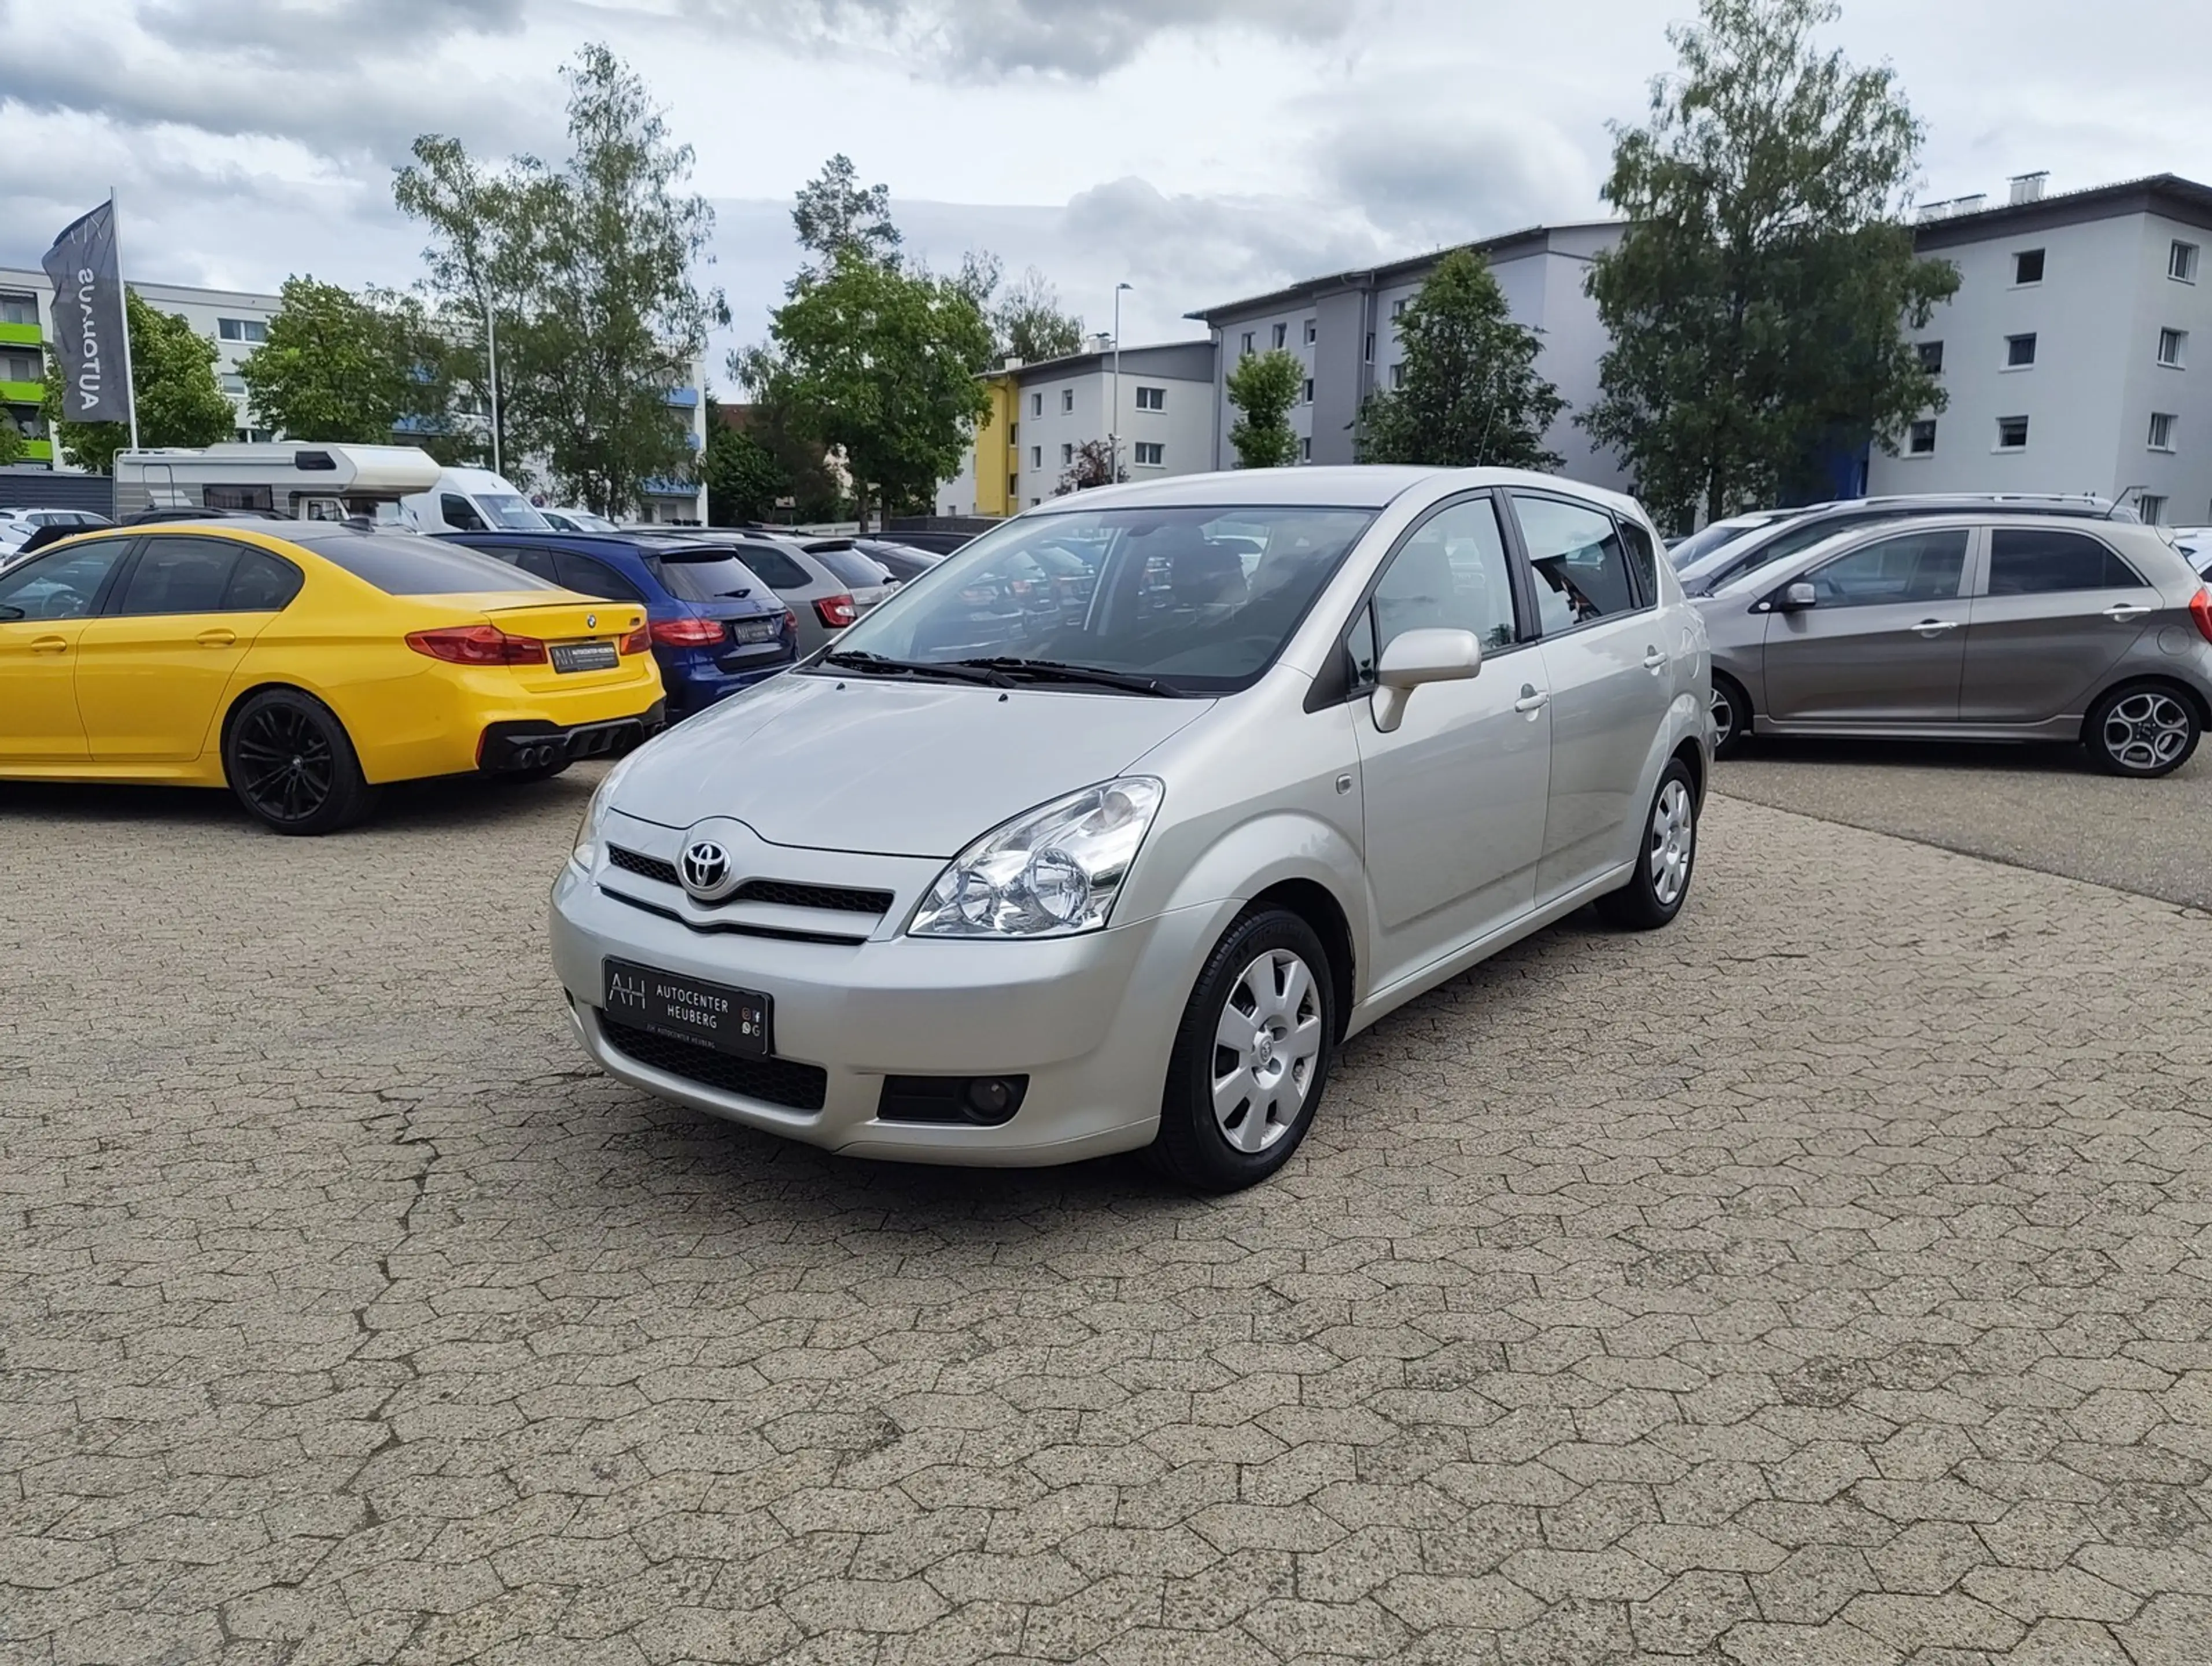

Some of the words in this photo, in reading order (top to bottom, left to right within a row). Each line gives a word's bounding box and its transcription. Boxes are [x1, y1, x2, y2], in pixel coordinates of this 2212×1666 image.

[609, 972, 646, 1009] AH
[656, 984, 729, 1013] AUTOCENTER
[667, 1004, 717, 1029] HEUBERG
